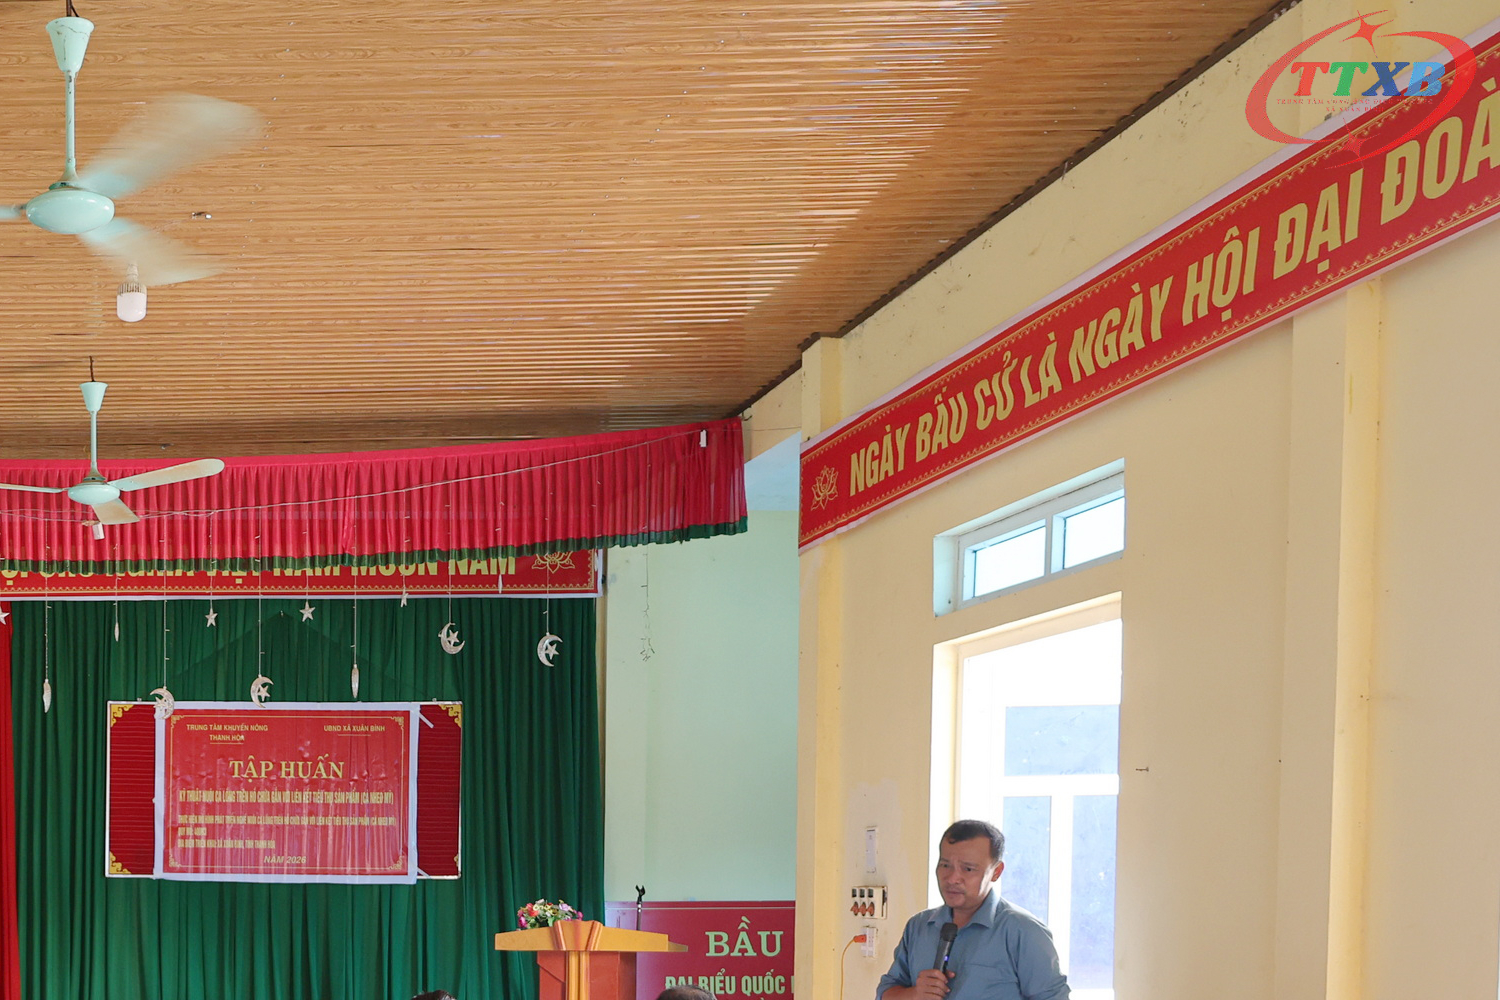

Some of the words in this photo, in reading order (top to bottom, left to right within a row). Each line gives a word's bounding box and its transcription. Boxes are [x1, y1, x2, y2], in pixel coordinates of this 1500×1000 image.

[850, 422, 911, 497] NGÀY
[974, 350, 1018, 431] CỬ
[1020, 332, 1062, 408] LÀ
[1069, 275, 1174, 382] NGÀY
[1182, 225, 1260, 322] HỘI
[1273, 168, 1364, 280] ĐẠI
[209, 722, 223, 731] TÂM
[224, 723, 249, 731] KHUYẾN
[250, 723, 268, 731] NÔNG
[324, 724, 342, 732] UBND
[343, 723, 351, 732] XÃ
[352, 723, 369, 732] XUÂN
[370, 723, 385, 732] BÌNH
[229, 754, 274, 783] TẬP
[280, 753, 345, 779] HUẤN
[264, 854, 284, 863] NĂM
[286, 856, 306, 864] 2026
[705, 916, 784, 957] BẦU
[698, 968, 736, 995] BIỂU
[741, 969, 786, 996] QUỐC
